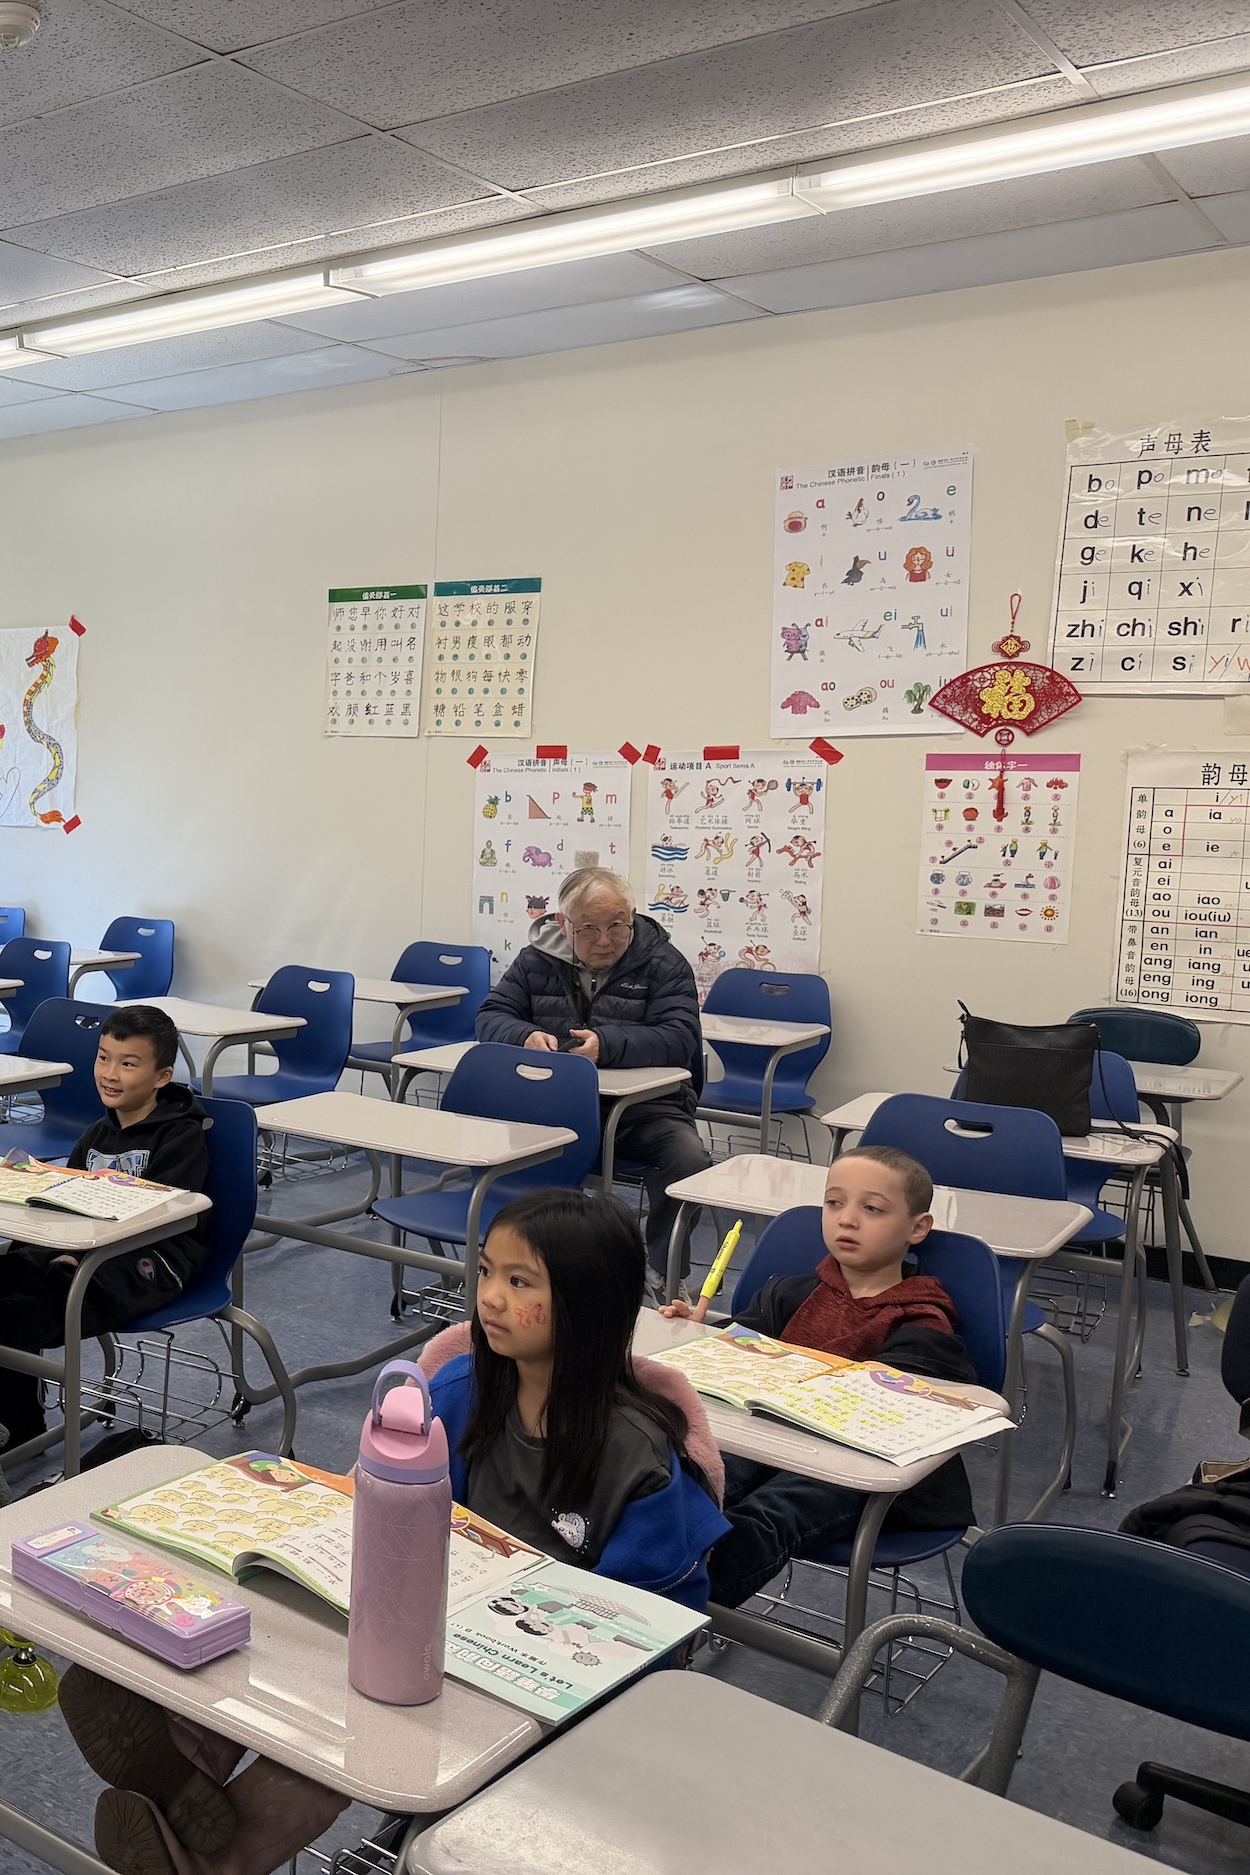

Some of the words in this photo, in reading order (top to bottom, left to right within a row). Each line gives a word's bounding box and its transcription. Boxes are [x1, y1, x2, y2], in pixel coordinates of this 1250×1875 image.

[1137, 430, 1211, 458] 声母表
[828, 466, 864, 478] 汉语拼音
[810, 480, 835, 488] Chinese
[837, 476, 865, 484] Phonetic
[816, 498, 826, 509] a
[876, 491, 885, 501] o
[946, 485, 956, 496] e
[878, 551, 887, 561] u
[362, 591, 397, 600] 偏旁部首一
[470, 585, 508, 594] 偏旁部首二
[815, 616, 829, 628] ai
[883, 609, 897, 621] ei
[940, 606, 953, 618] ui
[821, 681, 836, 691] ao
[880, 678, 894, 688] ou
[980, 670, 1035, 720] 福
[670, 762, 702, 770] 运动项目
[705, 762, 712, 770] A
[1201, 763, 1248, 786] 韵母
[505, 790, 512, 803] b
[552, 792, 560, 804] p
[606, 794, 618, 804] m
[1164, 809, 1174, 818] a
[1209, 809, 1222, 820] ia
[1163, 826, 1172, 834] o
[505, 840, 512, 852] f
[556, 839, 564, 851] d
[609, 842, 616, 854] t
[1162, 842, 1171, 851] e
[1206, 842, 1220, 852] ie
[1158, 859, 1172, 869] ai
[1158, 876, 1170, 886] ei
[501, 892, 508, 903] n
[1152, 892, 1172, 902] ao
[1198, 894, 1220, 905] iao
[1152, 909, 1170, 918] ou
[1184, 910, 1231, 922] iou(iu)
[1150, 926, 1170, 935] an
[1195, 928, 1218, 939] ian
[504, 939, 512, 950] k
[1150, 942, 1168, 951] en
[1199, 944, 1212, 955] in
[1144, 957, 1172, 969] ang
[1188, 958, 1220, 974] iang
[1143, 974, 1172, 986] eng
[1192, 976, 1215, 990] ing
[1142, 990, 1170, 1002] ong
[1186, 992, 1218, 1007] iong
[453, 1632, 500, 1656] Chinese
[475, 1632, 518, 1654] Workbook
[422, 1642, 432, 1682] owala
[502, 1654, 538, 1674] Learn
[540, 1670, 573, 1690] Let's
